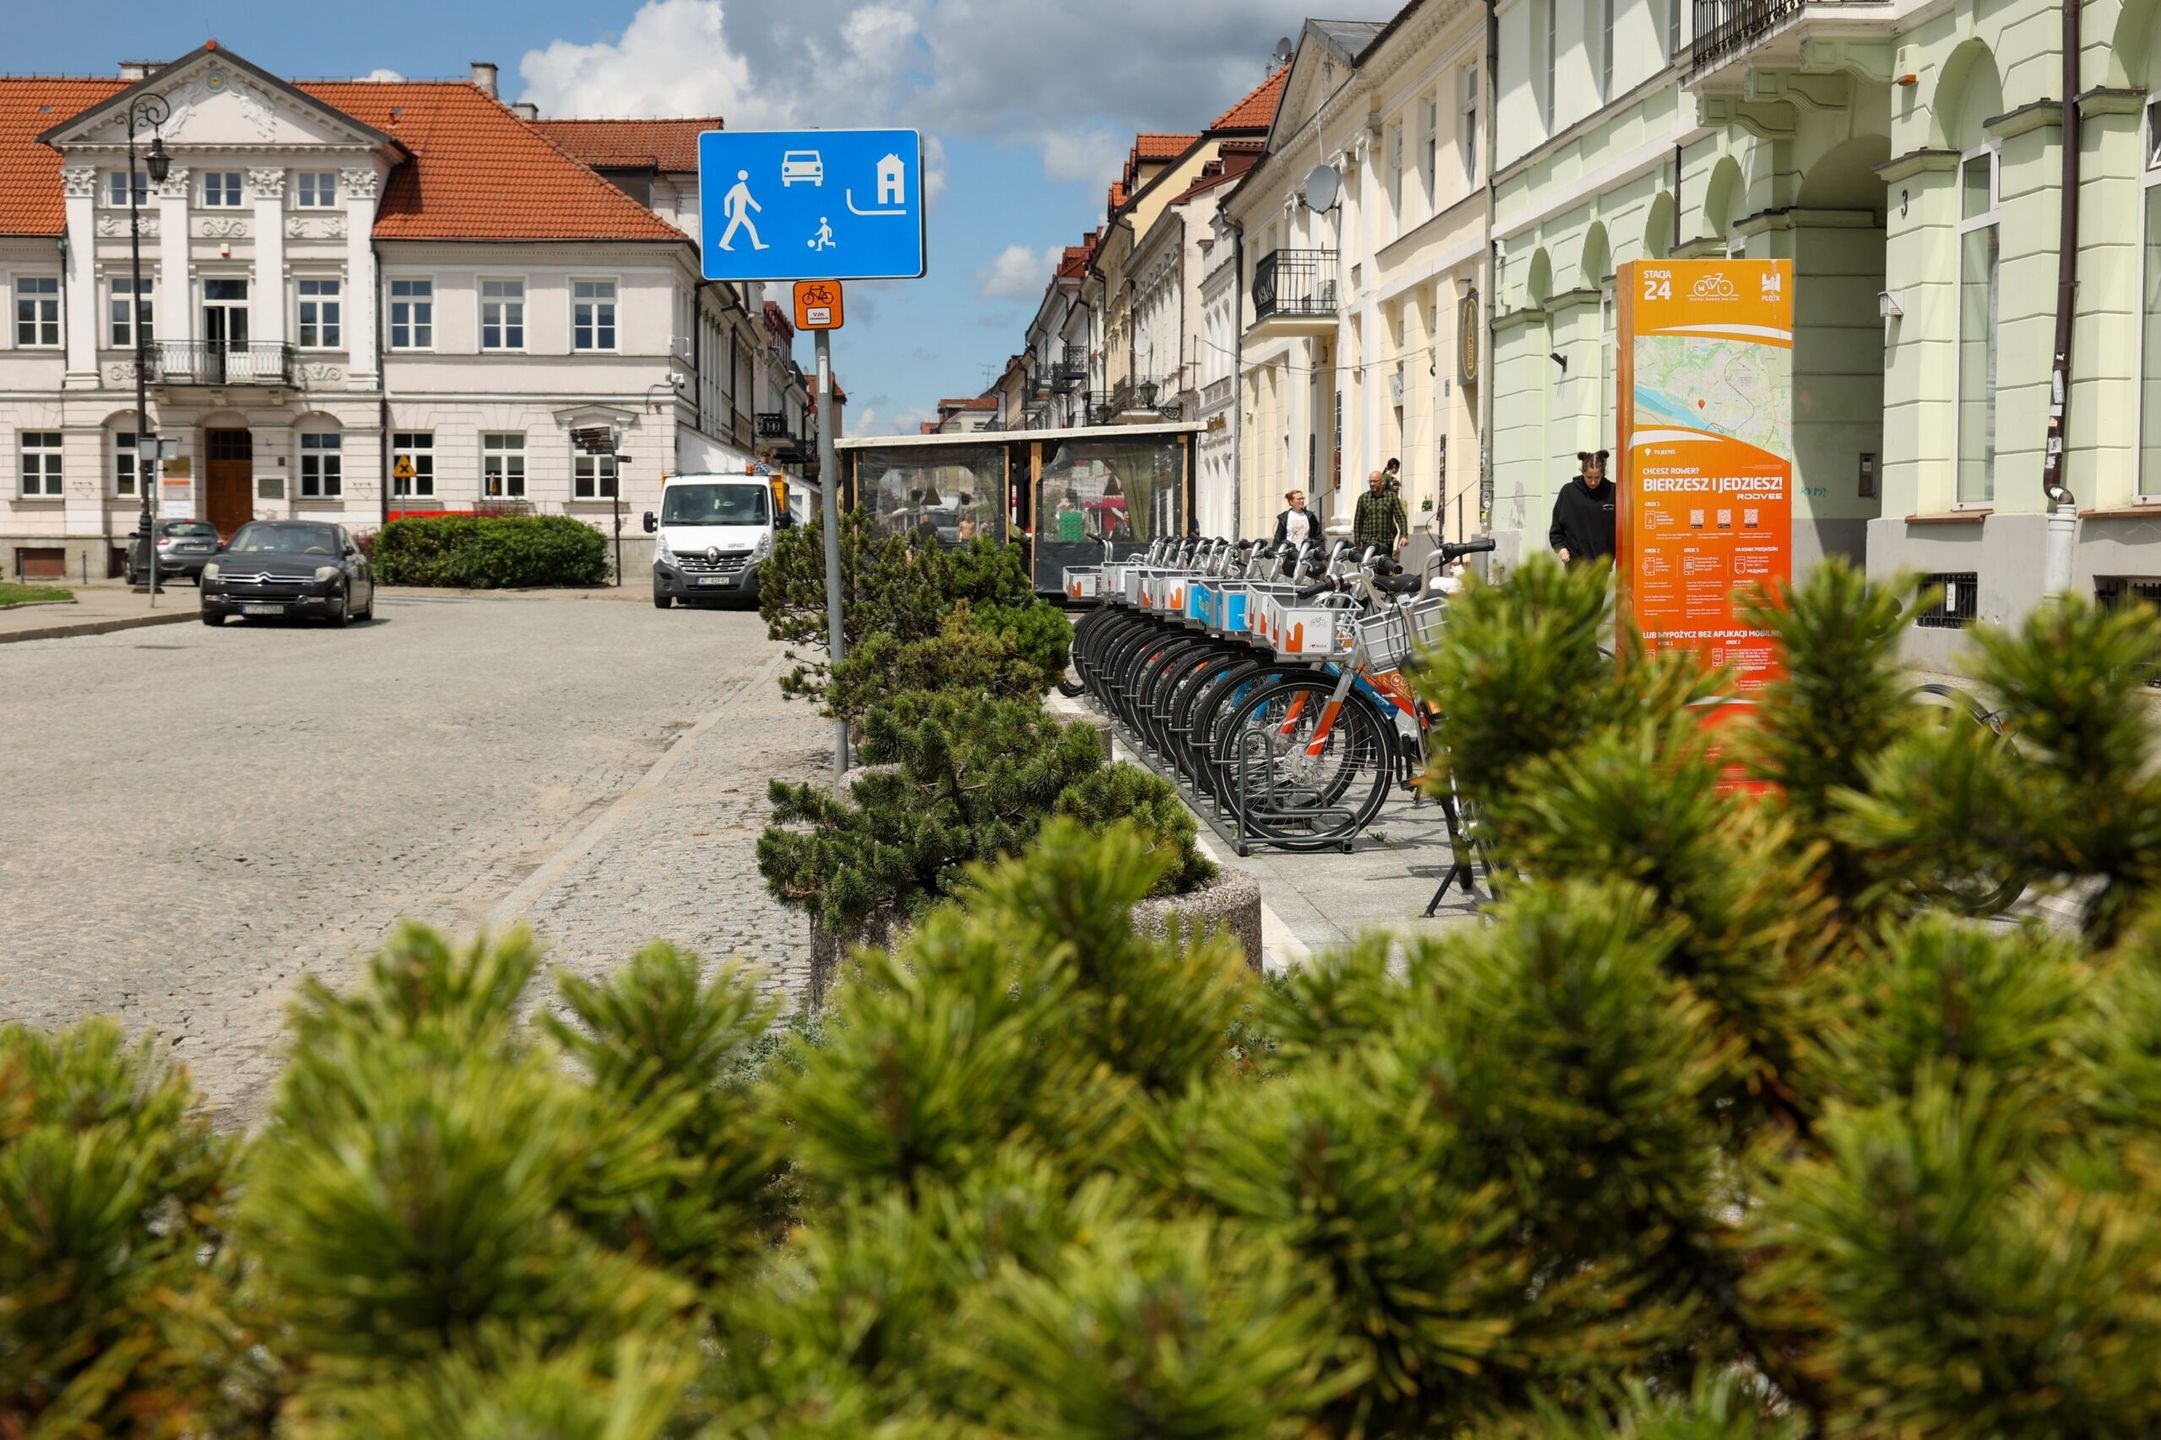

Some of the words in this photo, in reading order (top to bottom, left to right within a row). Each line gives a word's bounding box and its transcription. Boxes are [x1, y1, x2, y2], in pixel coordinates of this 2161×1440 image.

[1901, 189, 1909, 218] 3
[1643, 270, 1672, 280] STACJA
[1643, 280, 1672, 301] 24
[1643, 467, 1670, 475] CHCESZ
[1671, 466, 1700, 475] ROWER?
[1643, 477, 1709, 492] BIERZESZ
[1712, 477, 1716, 491] I
[1718, 476, 1783, 493] JEDZIESZ!
[1642, 631, 1657, 639] LUB
[1658, 629, 1697, 639] WYPOŻYCZ
[1698, 630, 1712, 638] BEZ
[1713, 630, 1748, 639] APLIKACJI
